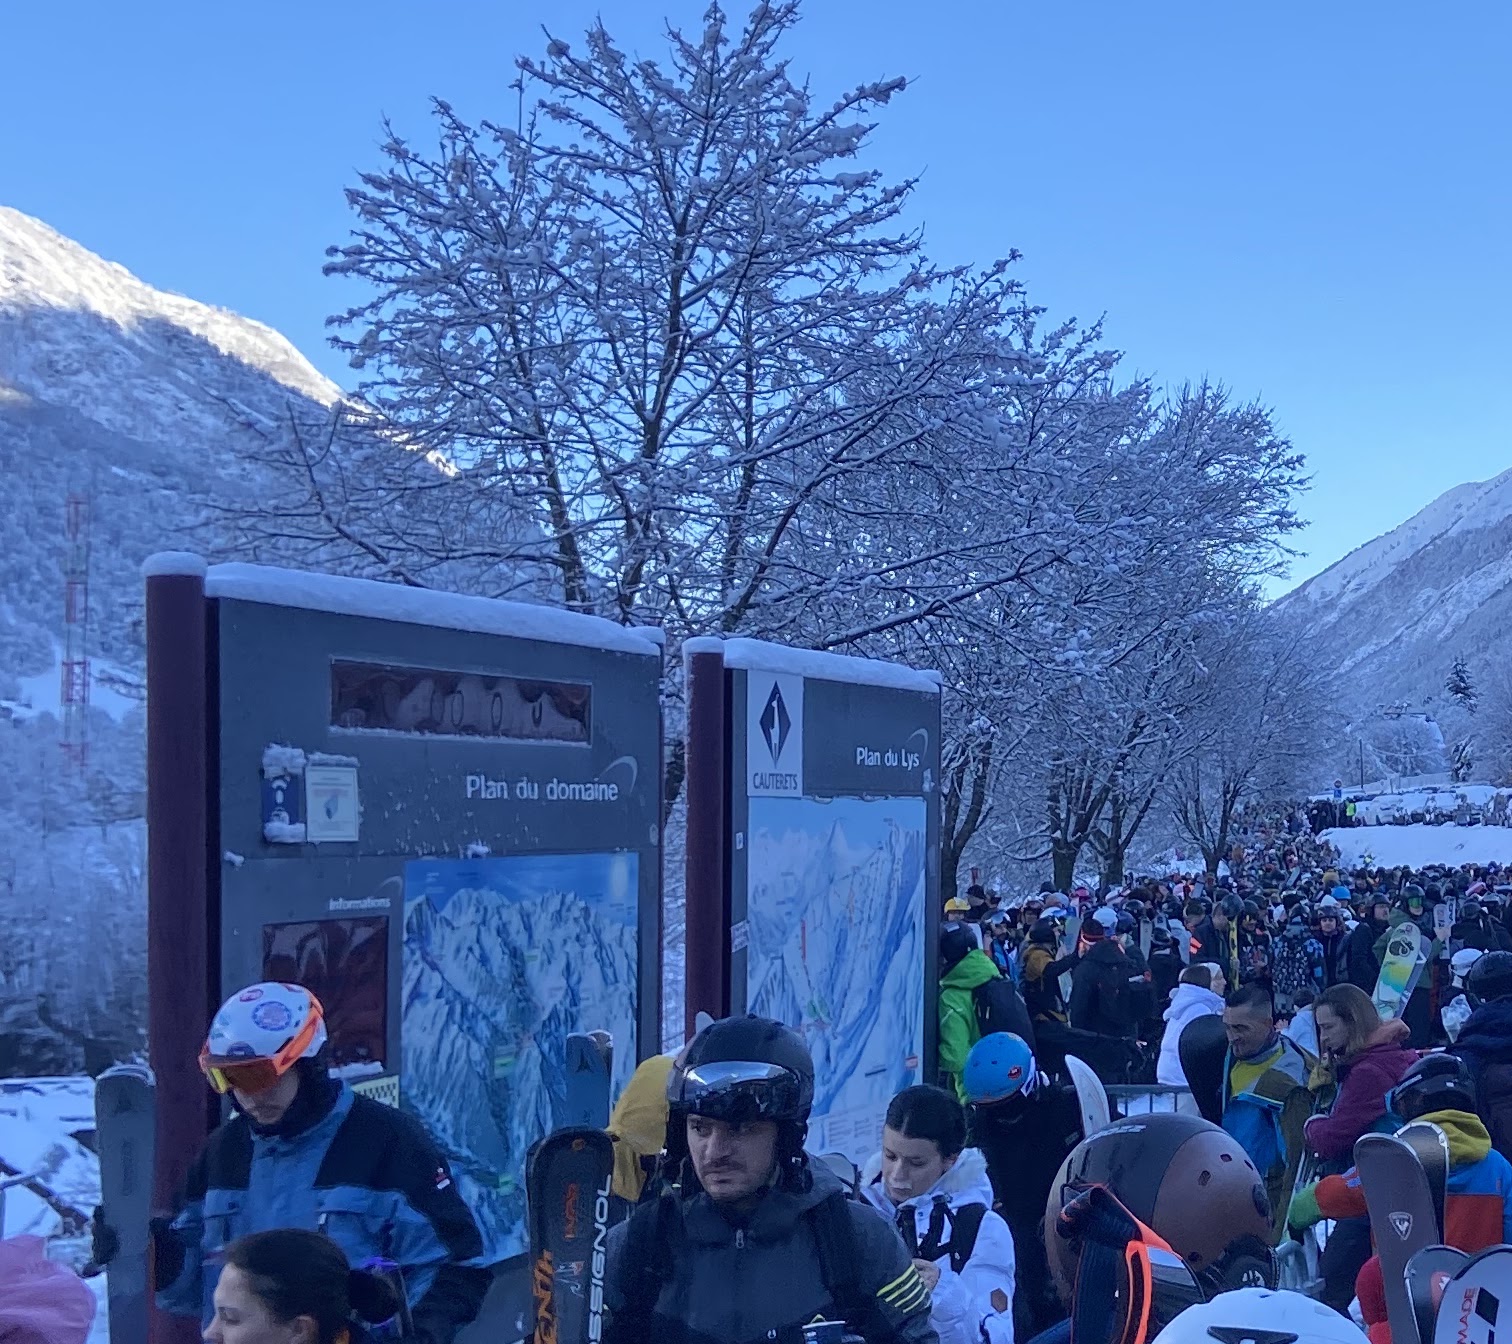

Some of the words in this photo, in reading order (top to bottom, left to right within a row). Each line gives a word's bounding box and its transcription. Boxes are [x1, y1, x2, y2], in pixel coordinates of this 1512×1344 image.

[856, 747, 881, 767] Plan
[884, 748, 898, 767] du
[901, 748, 920, 771] Lys
[466, 774, 509, 800] Plan
[516, 776, 539, 800] du
[546, 777, 619, 801] domaine
[753, 772, 798, 791] CAUTERETS
[1458, 1287, 1477, 1341] MADE
